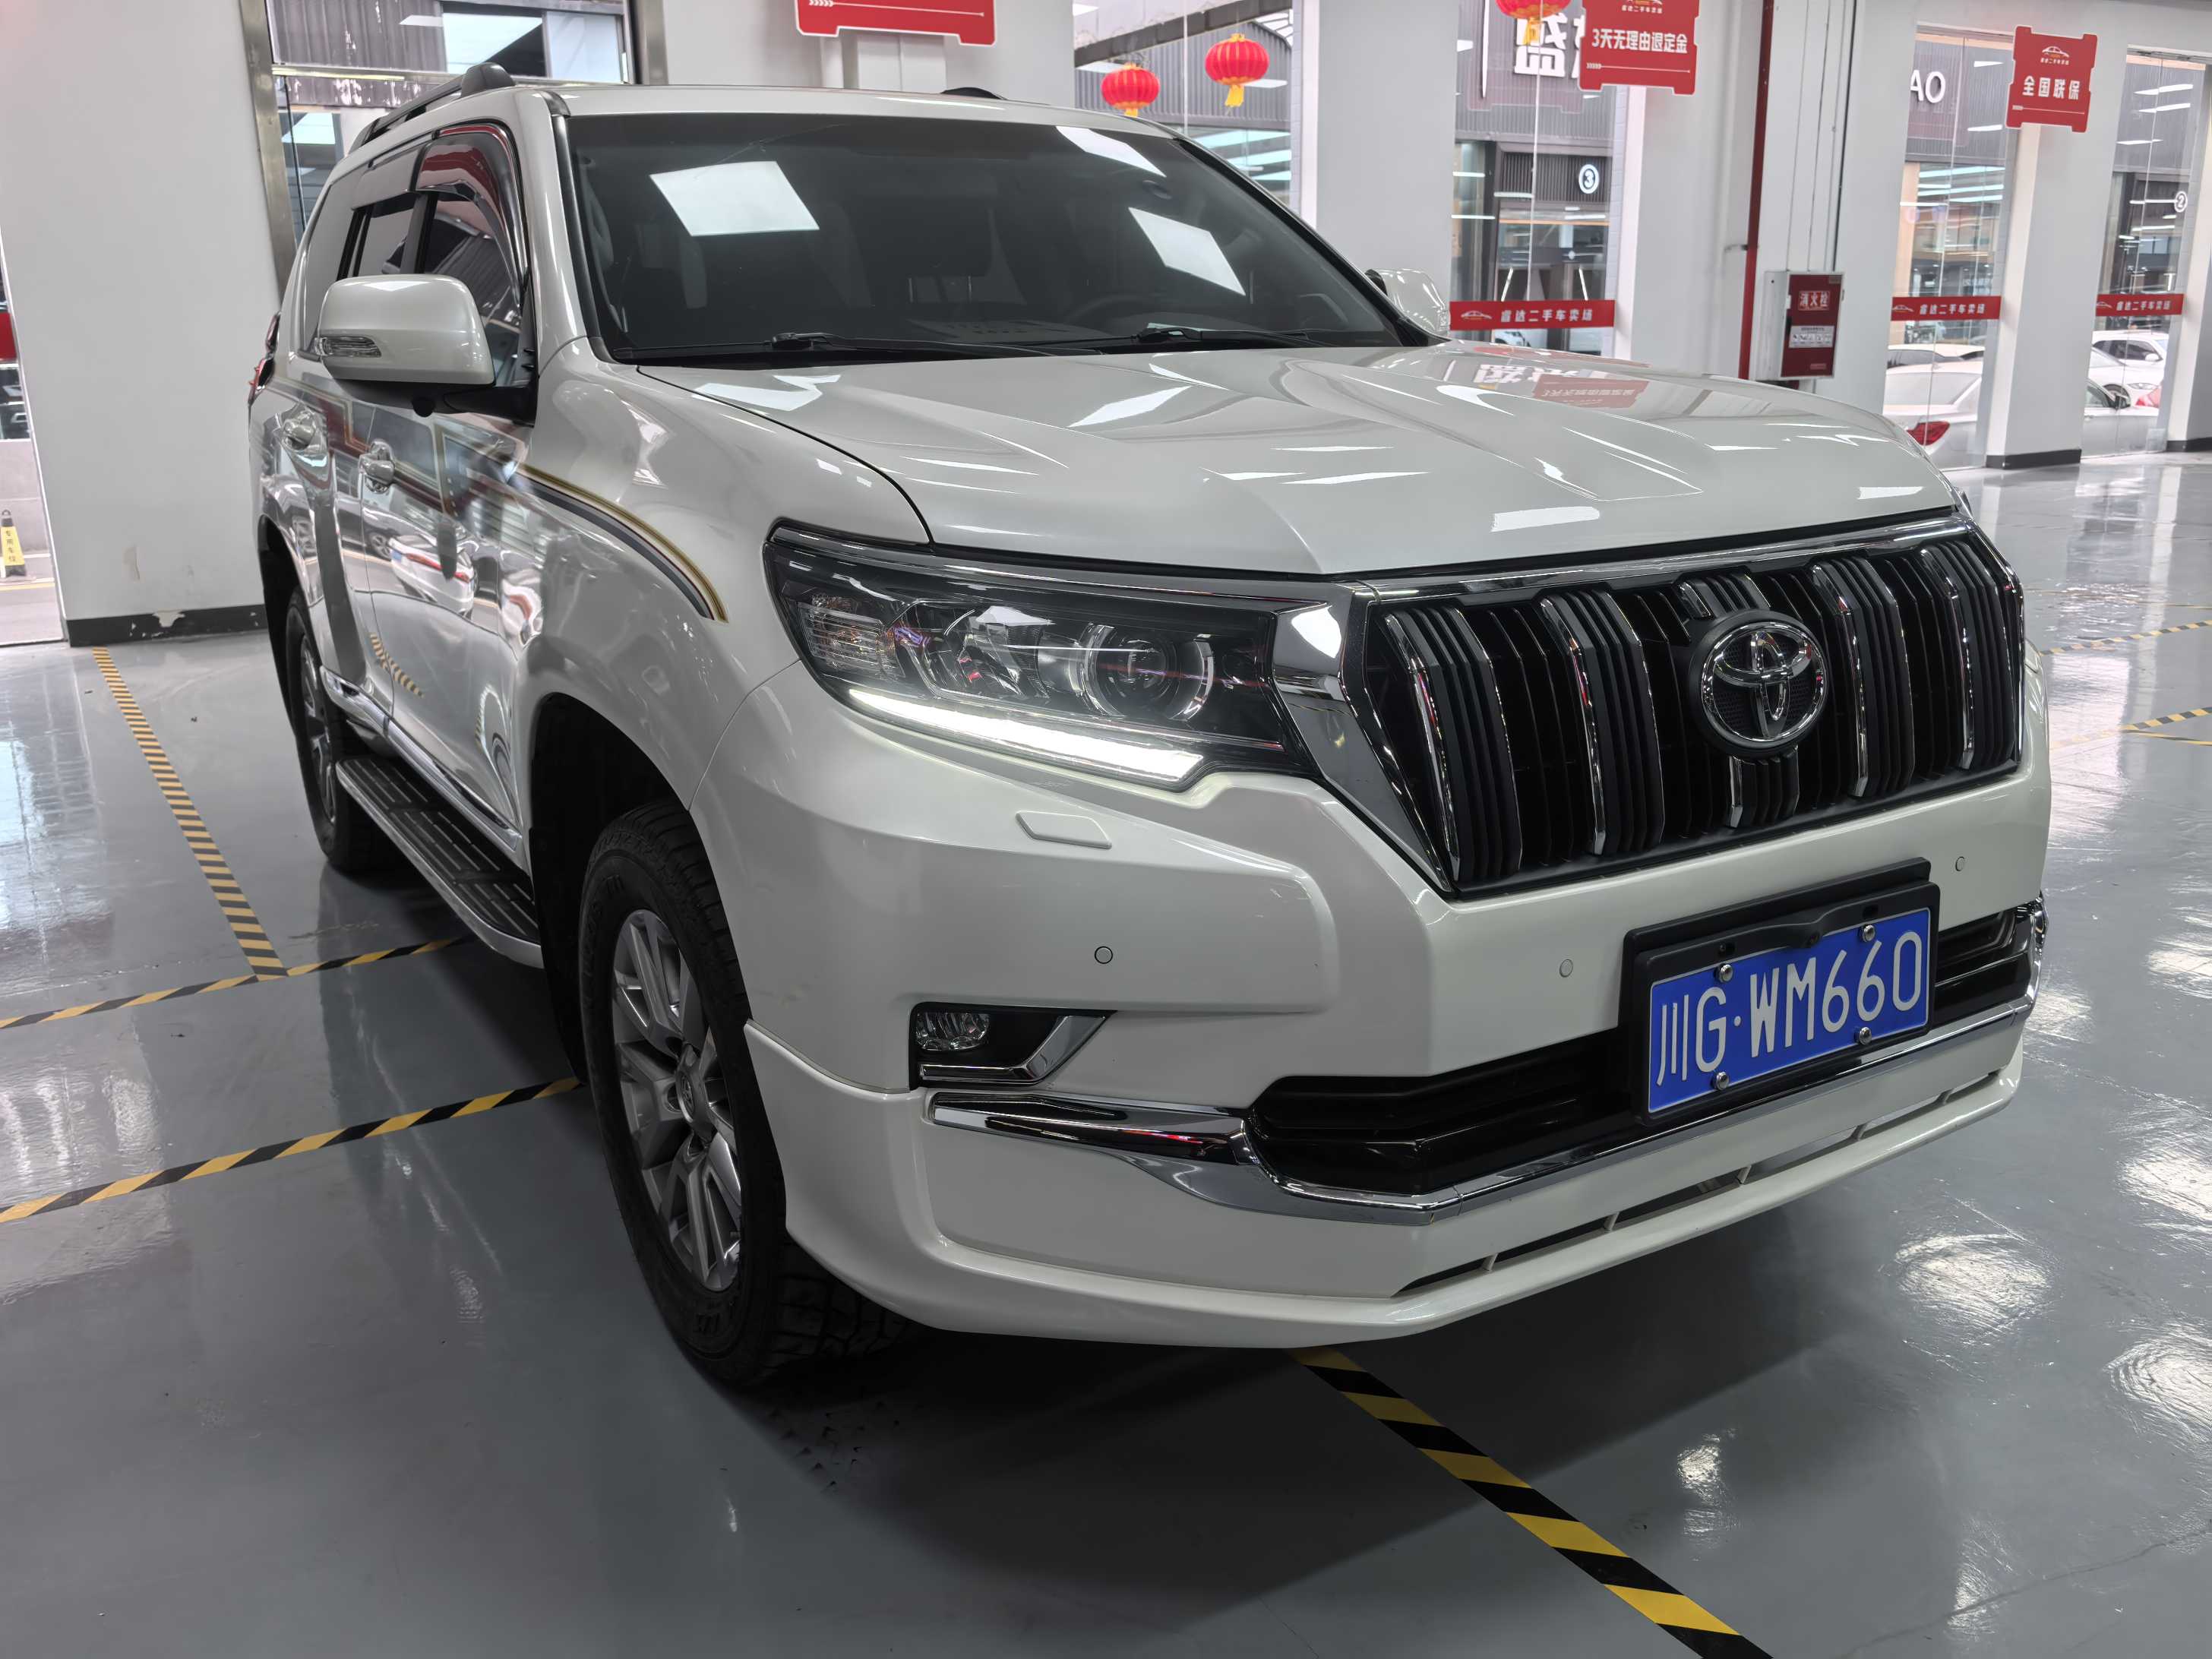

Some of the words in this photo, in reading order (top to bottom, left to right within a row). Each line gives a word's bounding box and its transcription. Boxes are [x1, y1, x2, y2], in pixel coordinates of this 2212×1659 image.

[1591, 28, 1688, 54] 3天无理由退定金
[2022, 75, 2081, 100] 全国联保
[1656, 931, 1922, 1086] 川G·WM660
